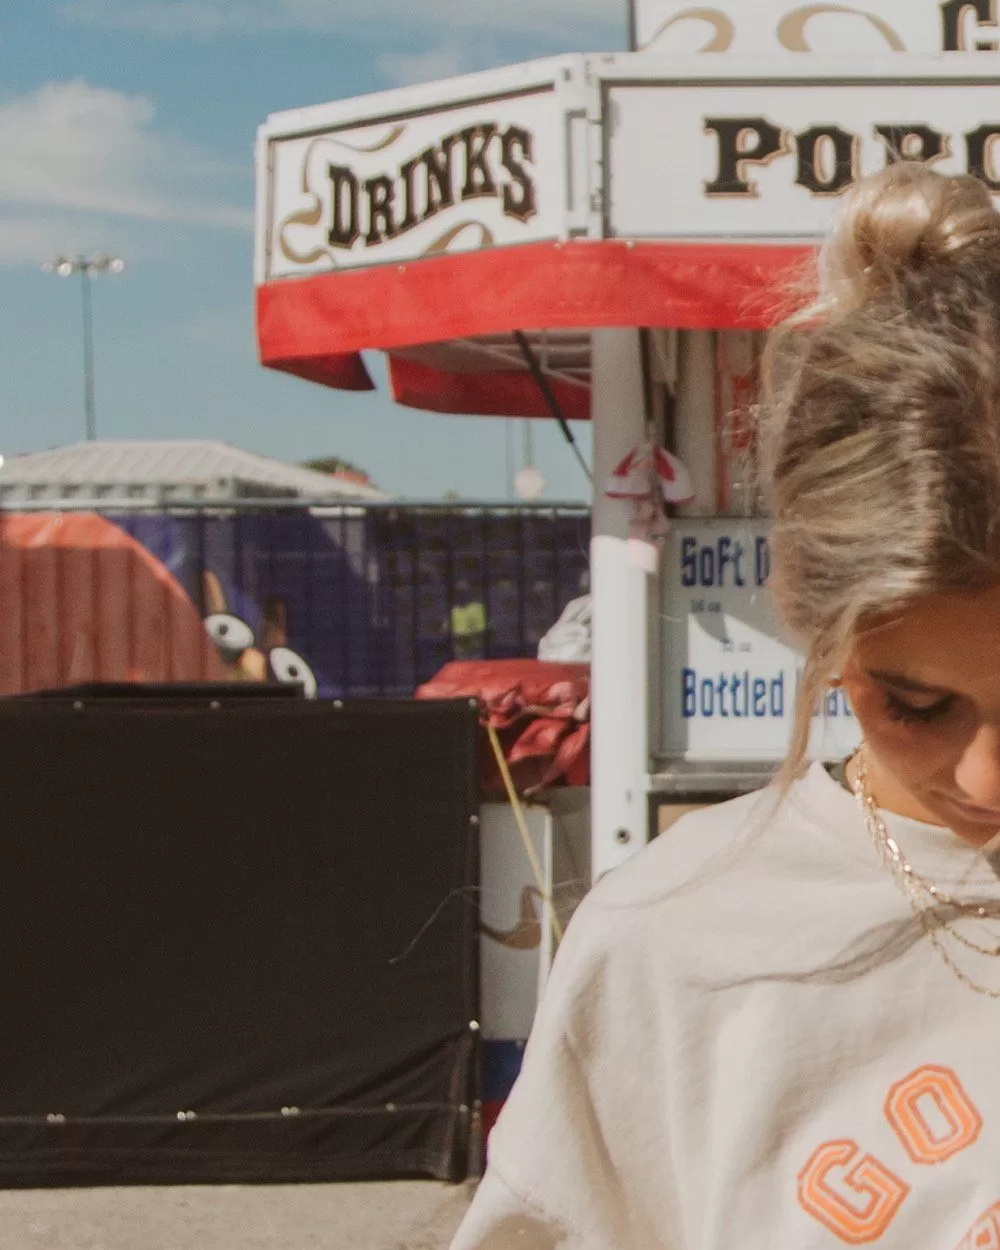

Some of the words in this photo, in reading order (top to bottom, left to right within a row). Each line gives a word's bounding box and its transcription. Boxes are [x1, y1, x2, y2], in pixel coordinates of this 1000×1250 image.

[327, 123, 537, 250] DRINKS
[682, 667, 785, 718] Bottled
[797, 1063, 983, 1246] GO
